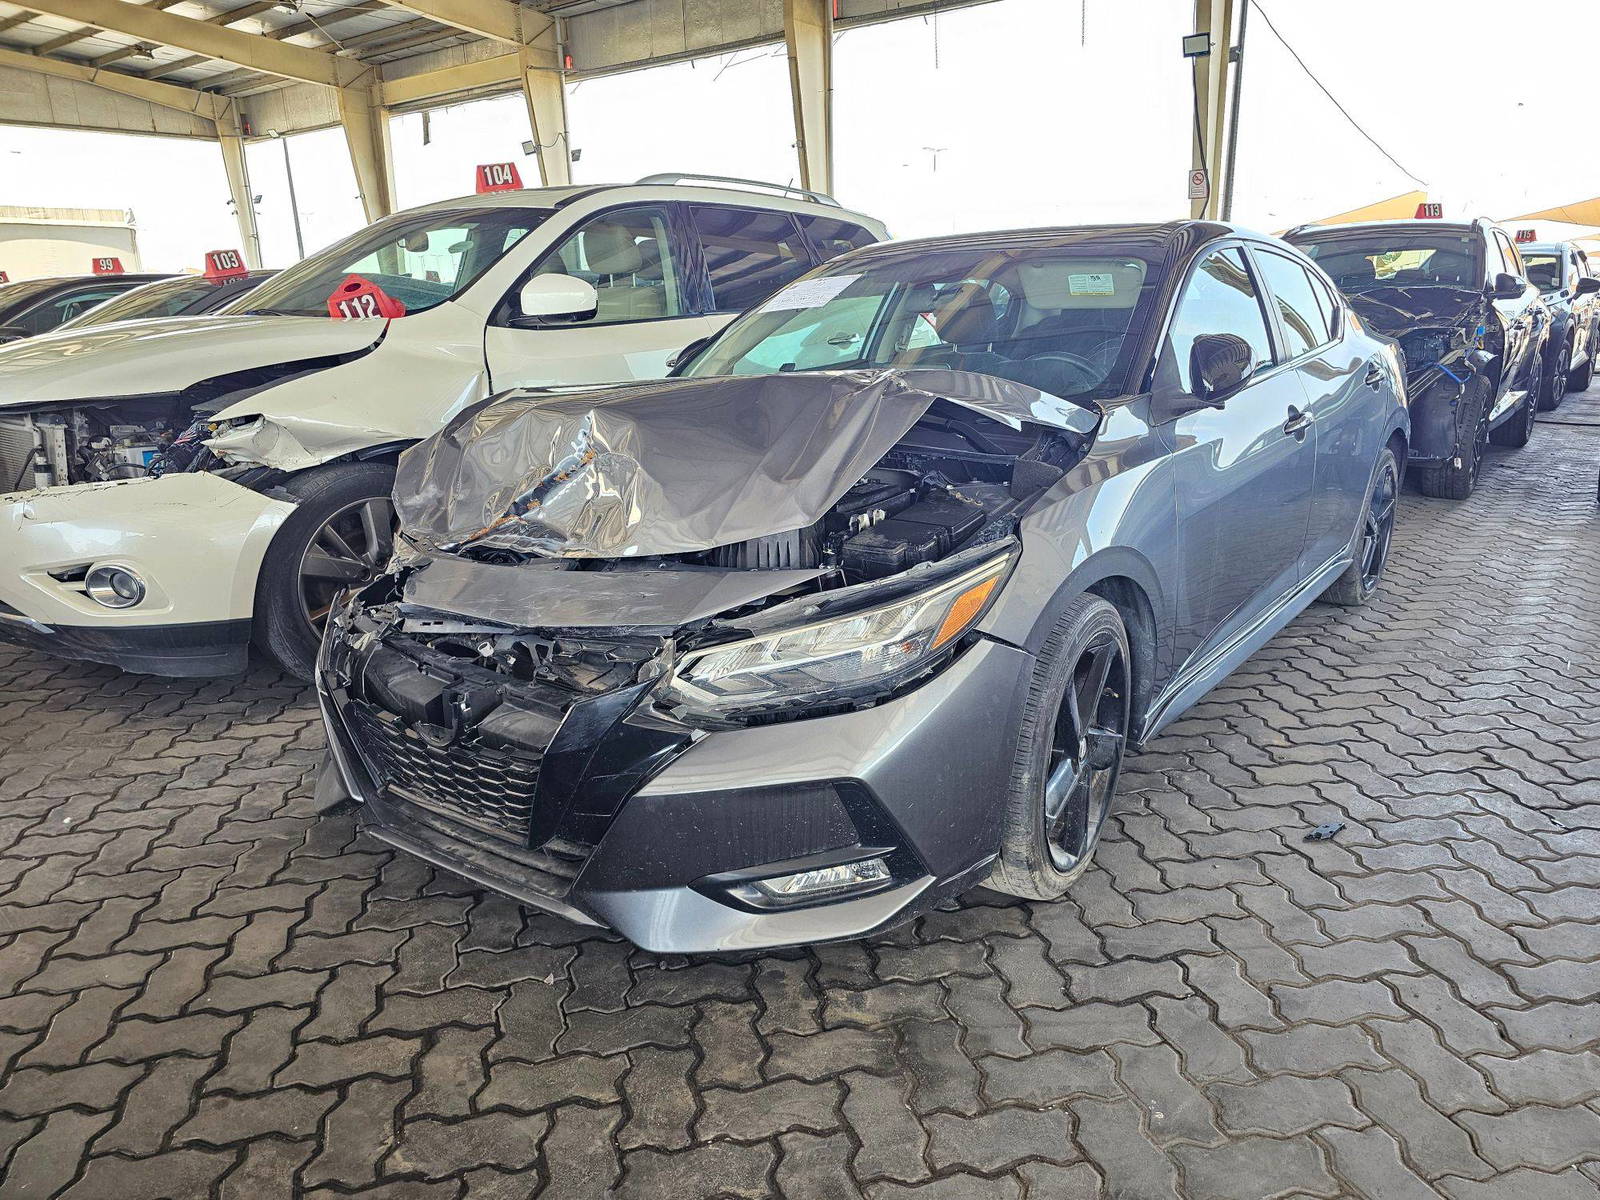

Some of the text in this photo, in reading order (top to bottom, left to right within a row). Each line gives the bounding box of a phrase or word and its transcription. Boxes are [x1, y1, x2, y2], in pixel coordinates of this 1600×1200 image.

[484, 164, 513, 186] 104
[1424, 203, 1440, 217] 113
[99, 258, 114, 271] 99
[212, 251, 239, 270] 103
[339, 294, 382, 320] 112
